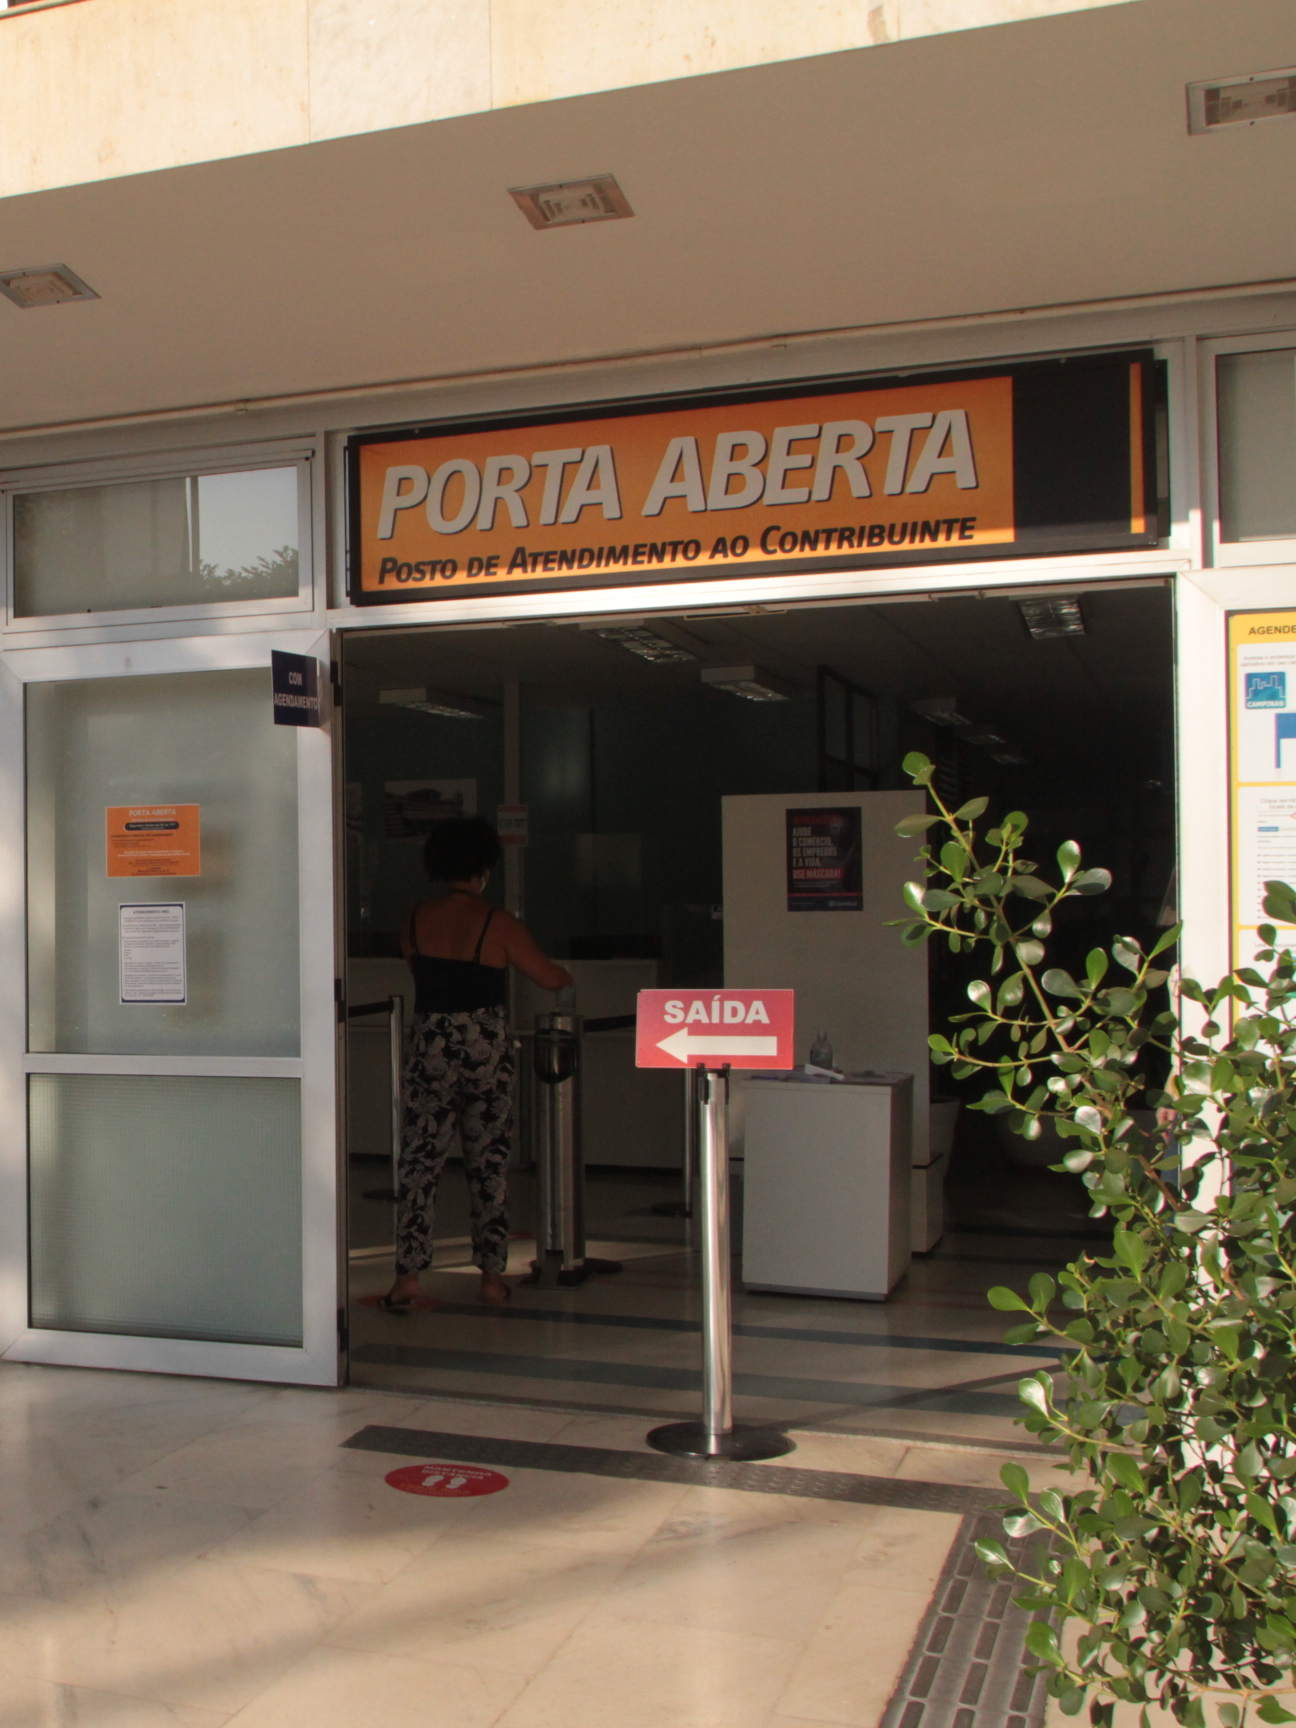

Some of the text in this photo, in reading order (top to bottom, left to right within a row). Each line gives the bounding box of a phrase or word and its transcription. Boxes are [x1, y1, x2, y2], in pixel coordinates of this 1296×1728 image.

[377, 408, 979, 540] PORTA ABERTA
[289, 672, 303, 686] COM
[274, 693, 318, 710] AGENDAMENTO
[1247, 700, 1284, 708] CAMPINAS
[151, 808, 177, 816] ABERTA
[792, 827, 812, 836] AJUDE
[803, 846, 837, 857] EMPREGOS
[792, 868, 841, 879] USE MÁSCARA!
[663, 994, 771, 1024] SAÍDA
[422, 1469, 484, 1480] DISTÂNCIA
[424, 1465, 492, 1477] MANTENHA
